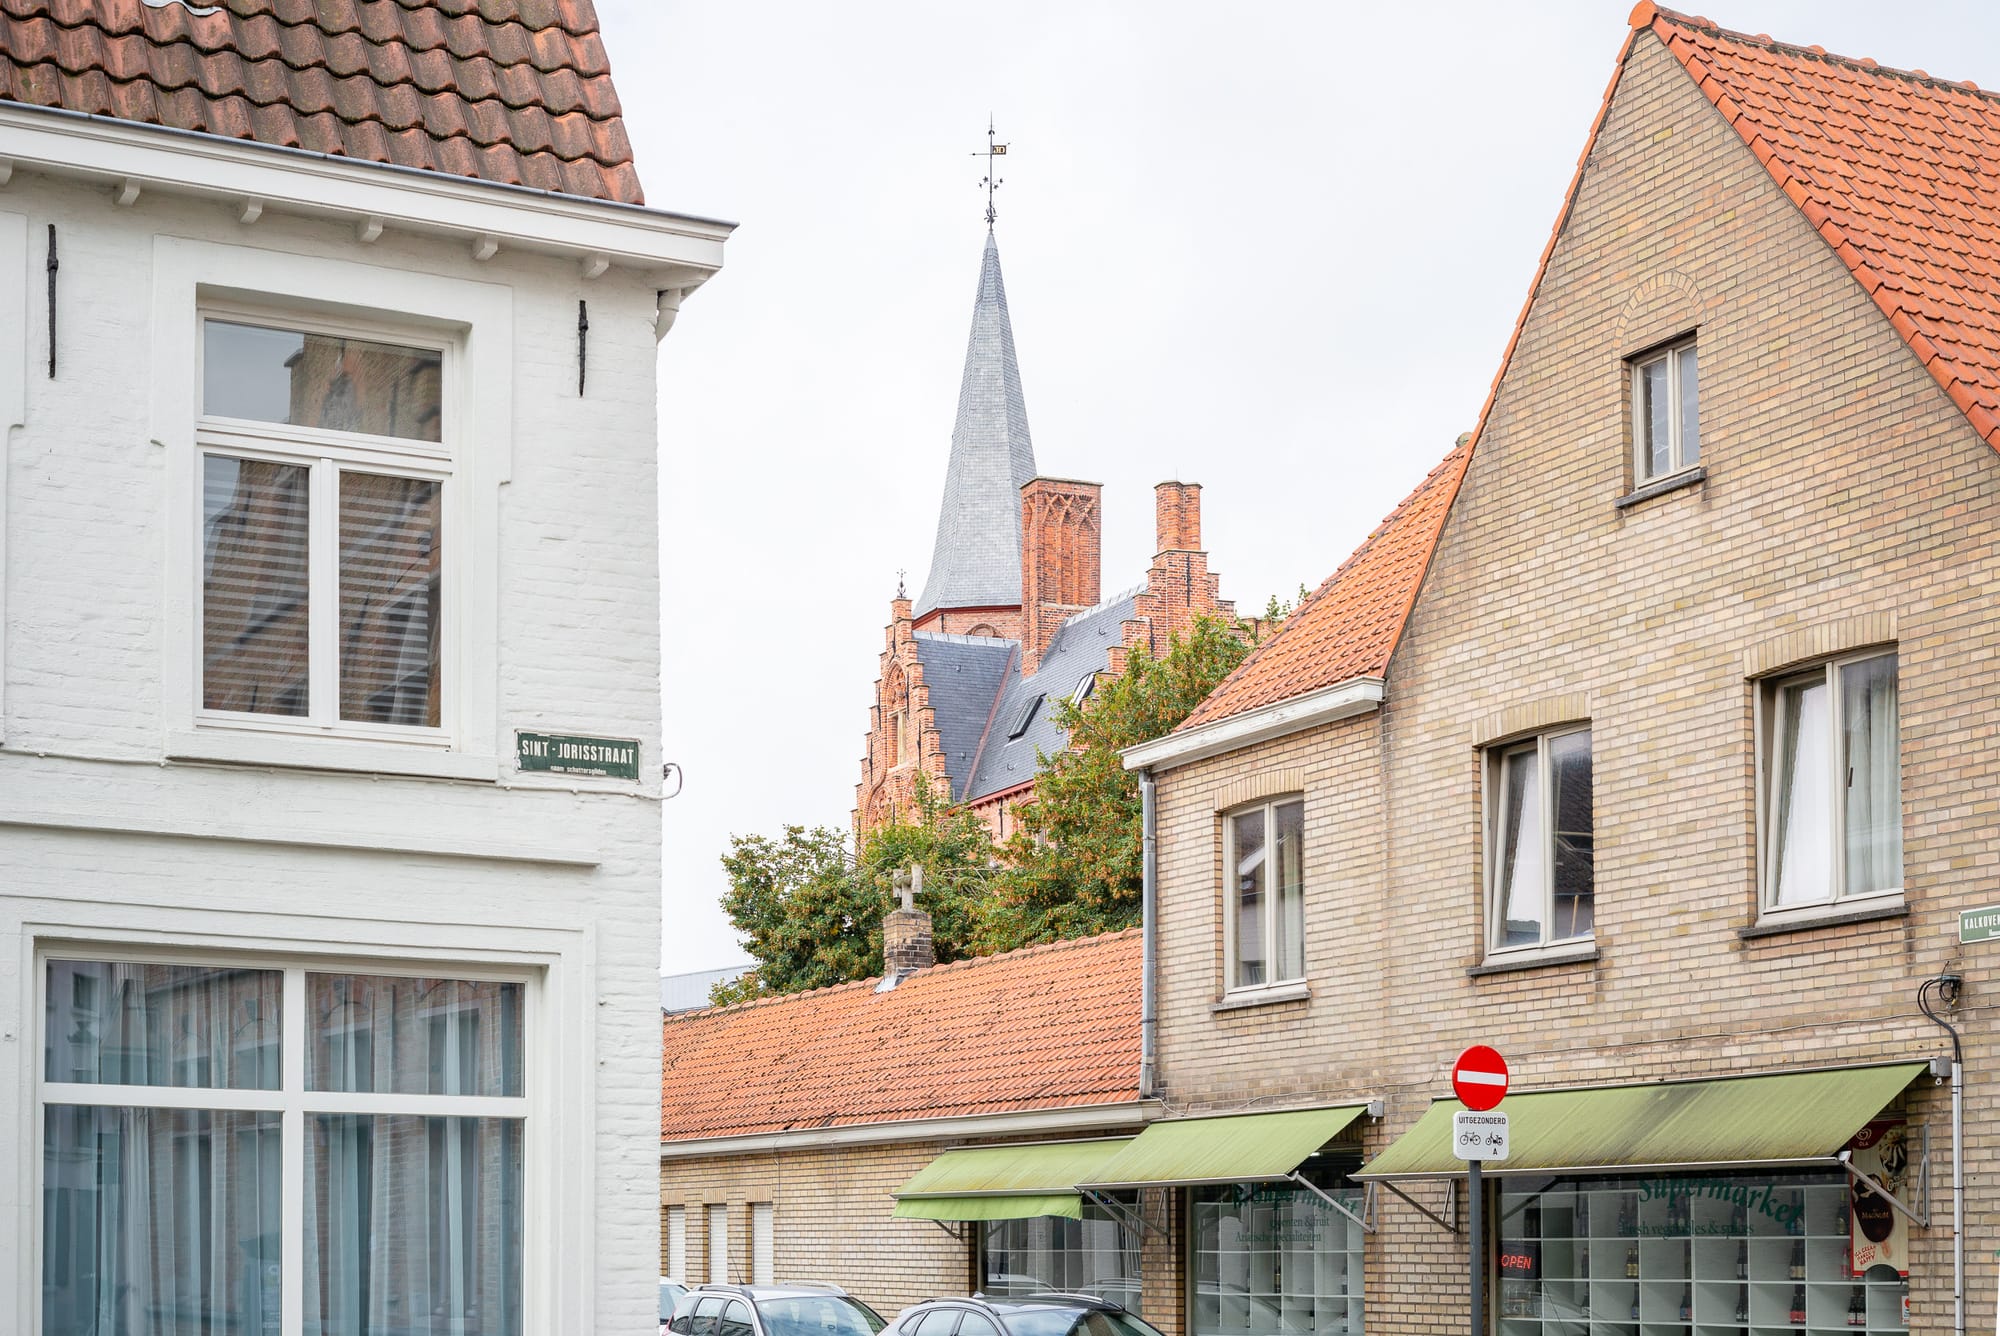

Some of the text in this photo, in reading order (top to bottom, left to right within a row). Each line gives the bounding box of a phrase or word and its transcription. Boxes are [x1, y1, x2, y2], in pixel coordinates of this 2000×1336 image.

[522, 739, 549, 757] SINT
[558, 742, 634, 764] JORISSTRAAT
[1459, 1116, 1507, 1125] UITGEZONDERD
[1492, 1147, 1498, 1156] A
[1501, 1254, 1532, 1270] OPEN
